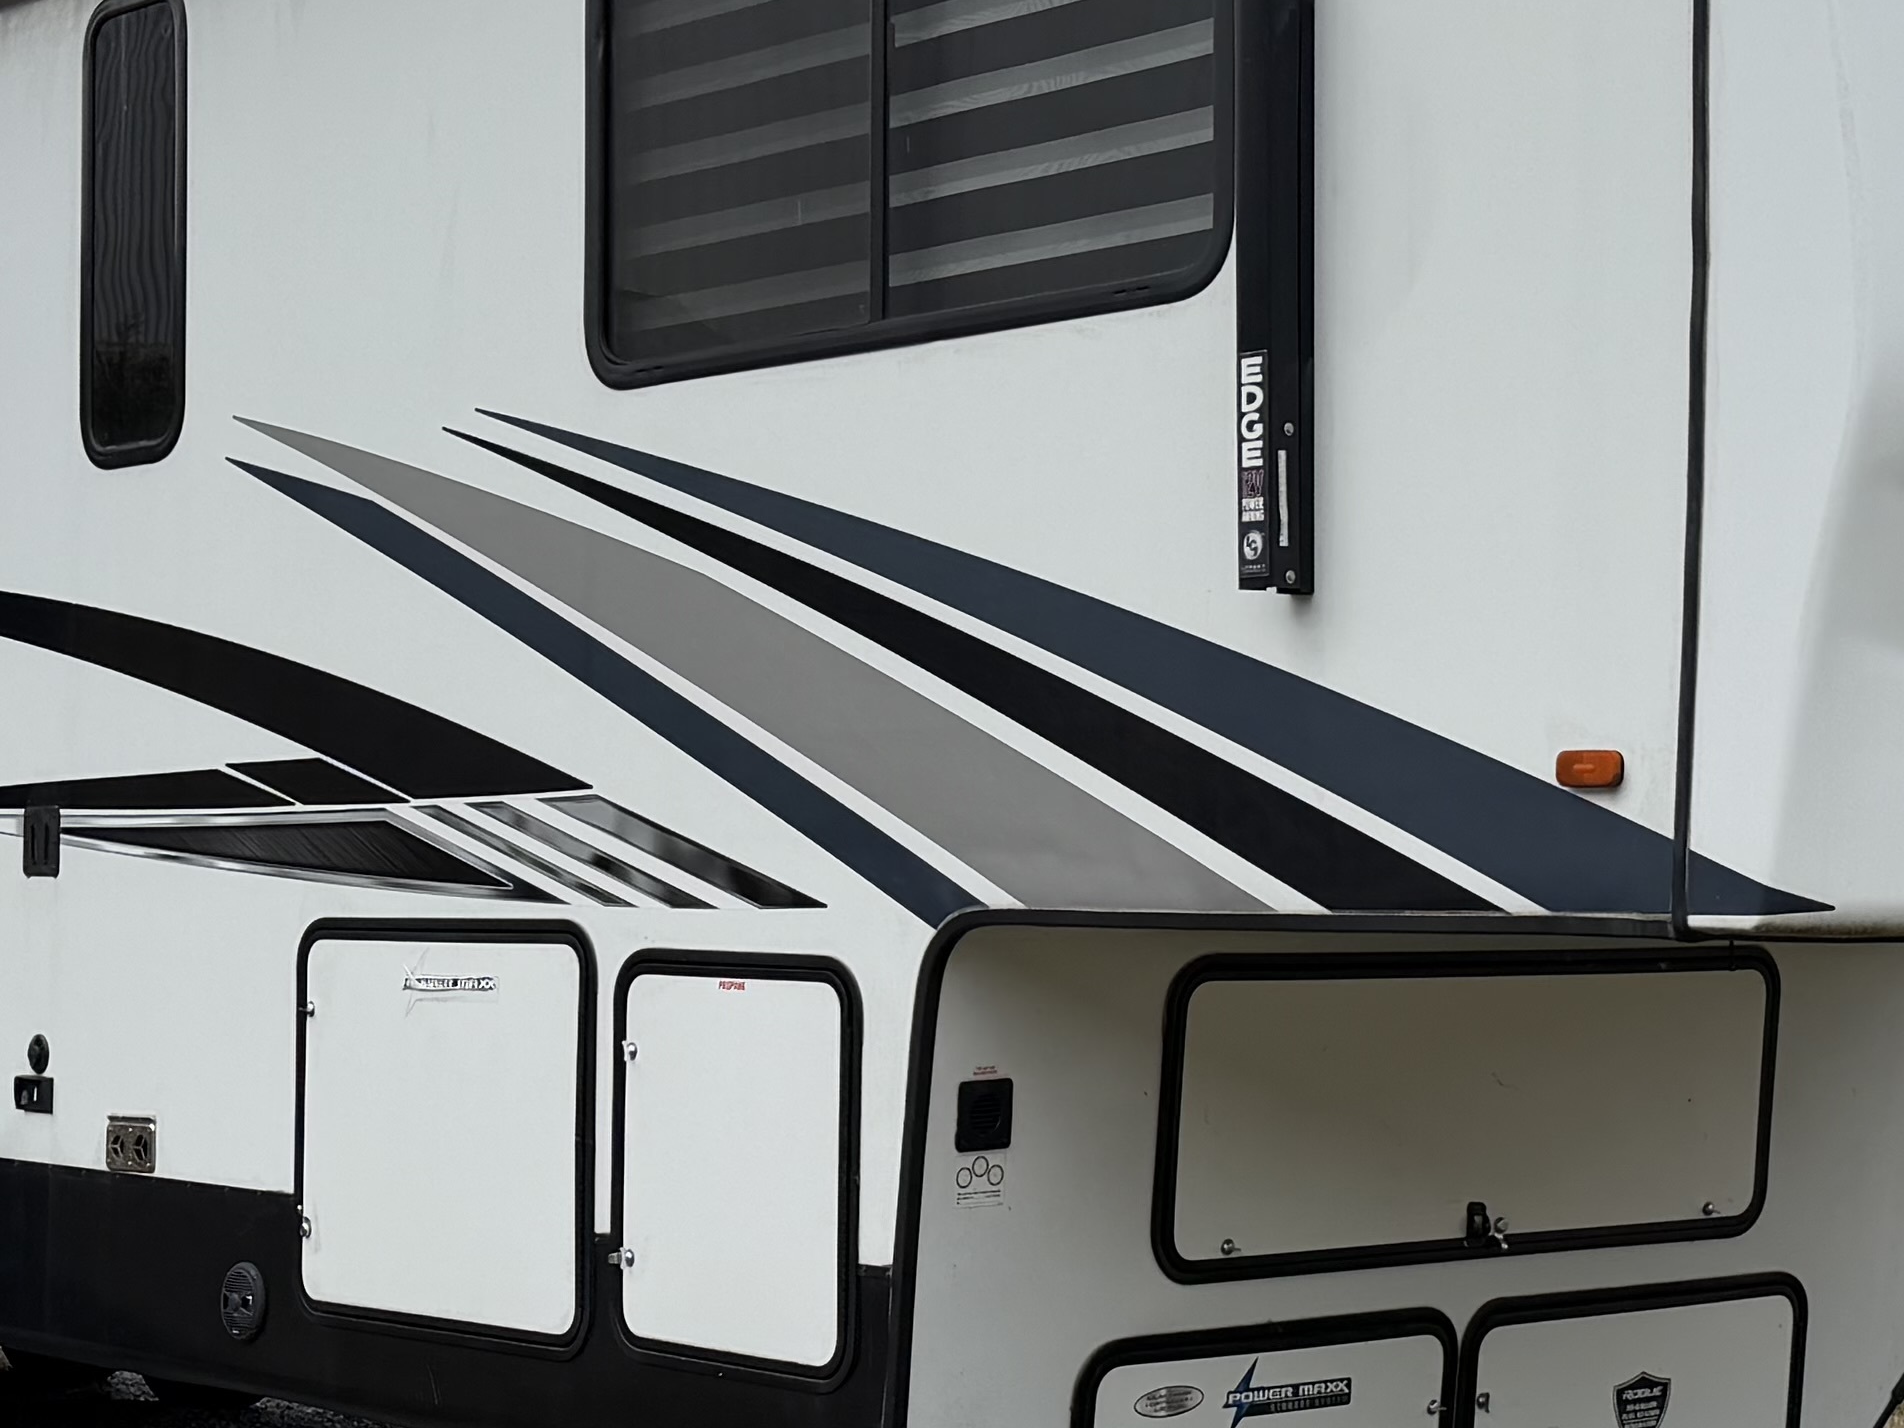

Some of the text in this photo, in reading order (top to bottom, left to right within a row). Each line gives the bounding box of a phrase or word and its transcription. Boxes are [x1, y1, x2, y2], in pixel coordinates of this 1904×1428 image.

[1240, 355, 1264, 468] EDGE
[1228, 1380, 1350, 1405] POWER MAXX
